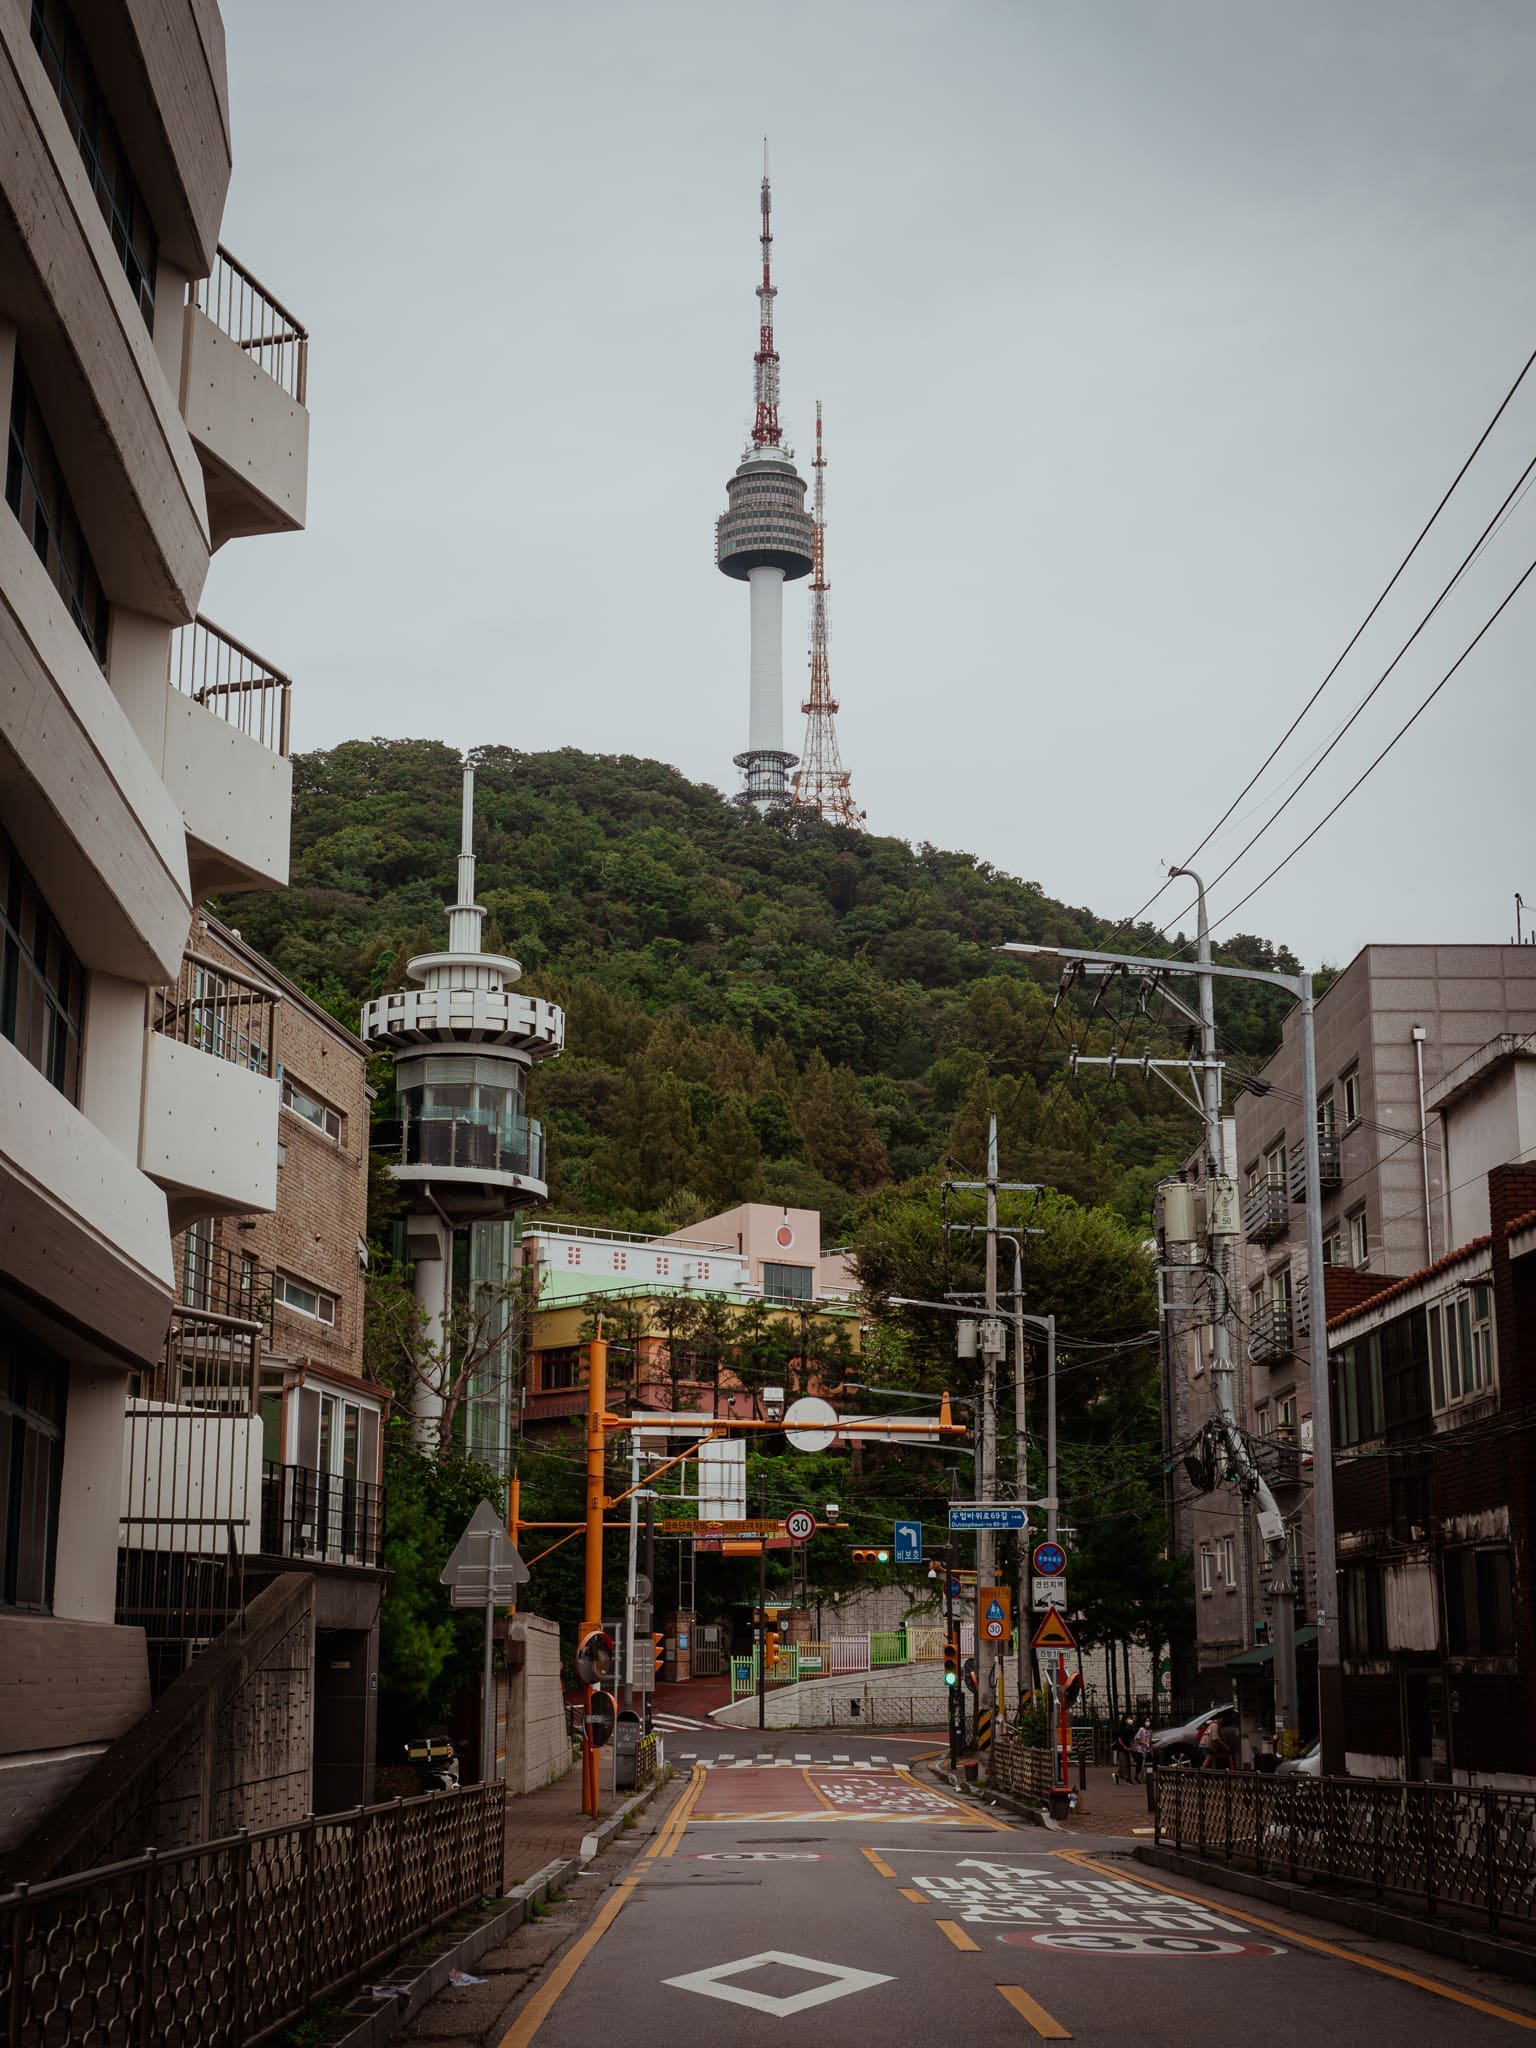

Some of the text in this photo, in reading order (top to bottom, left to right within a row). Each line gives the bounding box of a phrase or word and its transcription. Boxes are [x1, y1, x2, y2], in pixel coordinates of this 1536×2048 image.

[952, 1511, 1008, 1521] 두텁바위로69길
[793, 1519, 808, 1532] 30
[897, 1549, 920, 1560] 비보호
[1036, 1580, 1063, 1588] 견인지역
[990, 1625, 1000, 1633] 30
[911, 1876, 1152, 1894] 어린이
[926, 1889, 1212, 1912] 보호구역
[950, 1903, 1250, 1933] 천천히
[1047, 1933, 1221, 1952] 30
